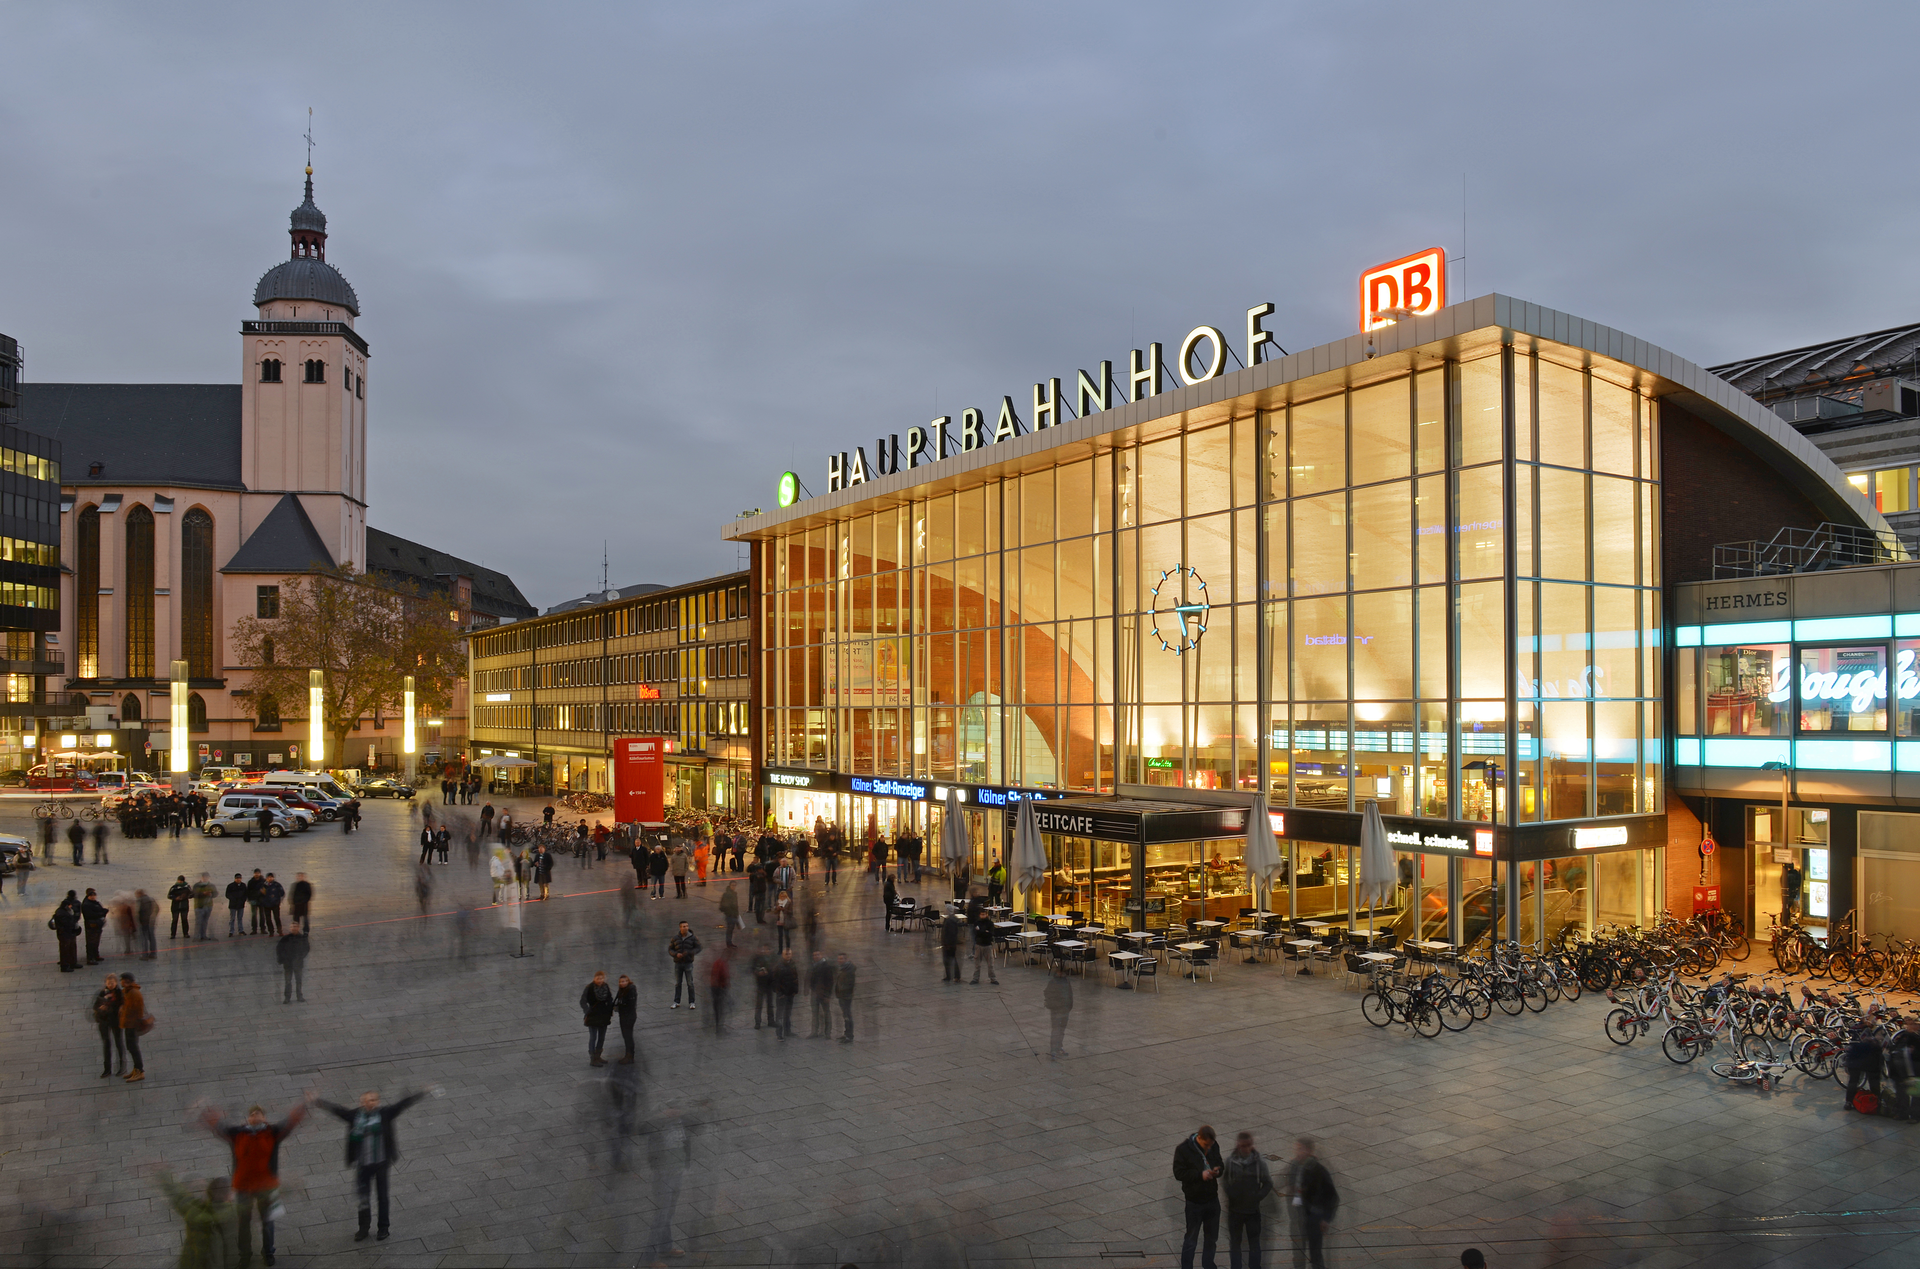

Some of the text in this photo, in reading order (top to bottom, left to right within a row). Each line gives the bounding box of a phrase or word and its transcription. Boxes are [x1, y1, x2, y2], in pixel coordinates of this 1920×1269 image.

[1370, 263, 1432, 322] DB
[828, 302, 1275, 493] HAUPTBAHNHOF
[780, 475, 793, 506] S
[770, 773, 810, 787] THE BODY SHOP
[851, 777, 873, 792] Kölner
[872, 778, 925, 800] Stadt-Anzeiger
[978, 788, 1007, 806] Kölner
